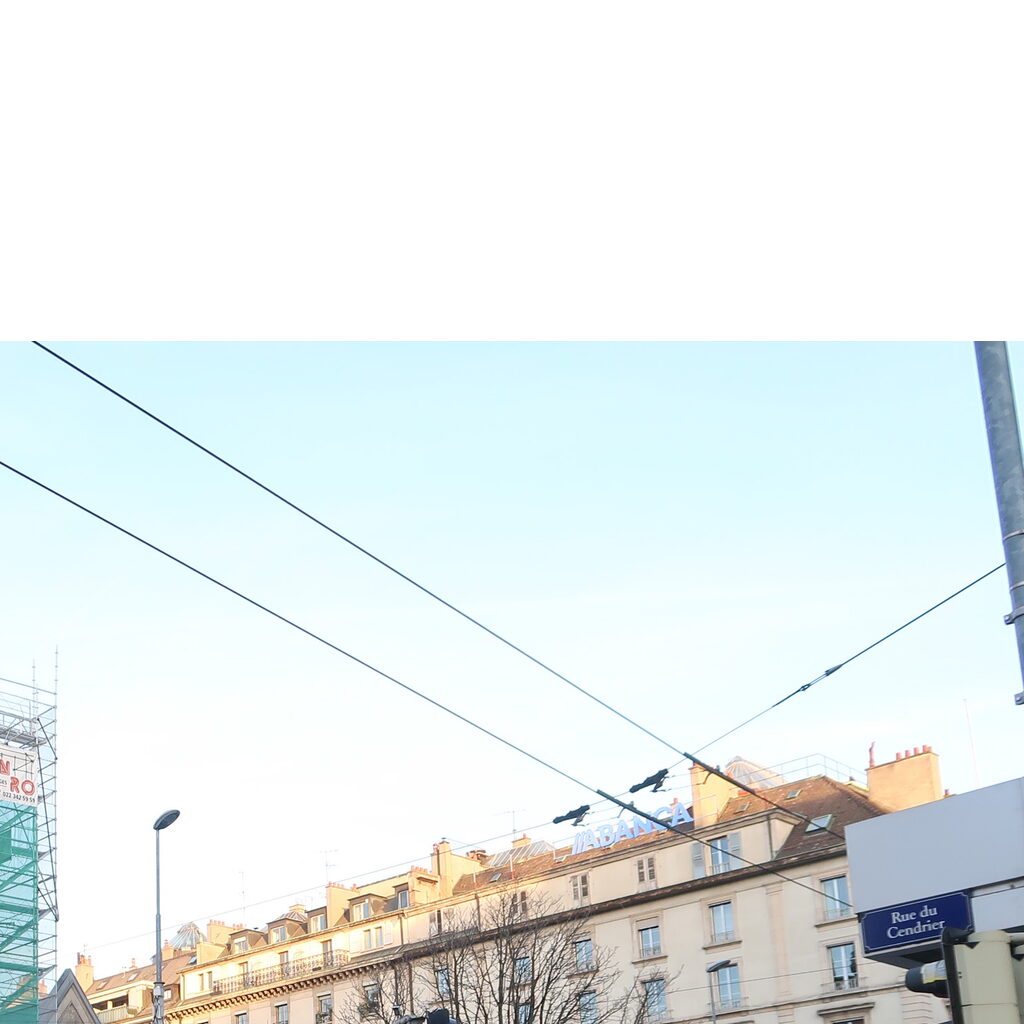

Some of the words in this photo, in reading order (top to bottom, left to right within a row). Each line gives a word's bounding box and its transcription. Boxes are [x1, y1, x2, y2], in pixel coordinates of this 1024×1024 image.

[10, 777, 35, 796] RO
[891, 911, 917, 924] Rue
[919, 905, 938, 918] du
[887, 920, 945, 939] Cendrier
